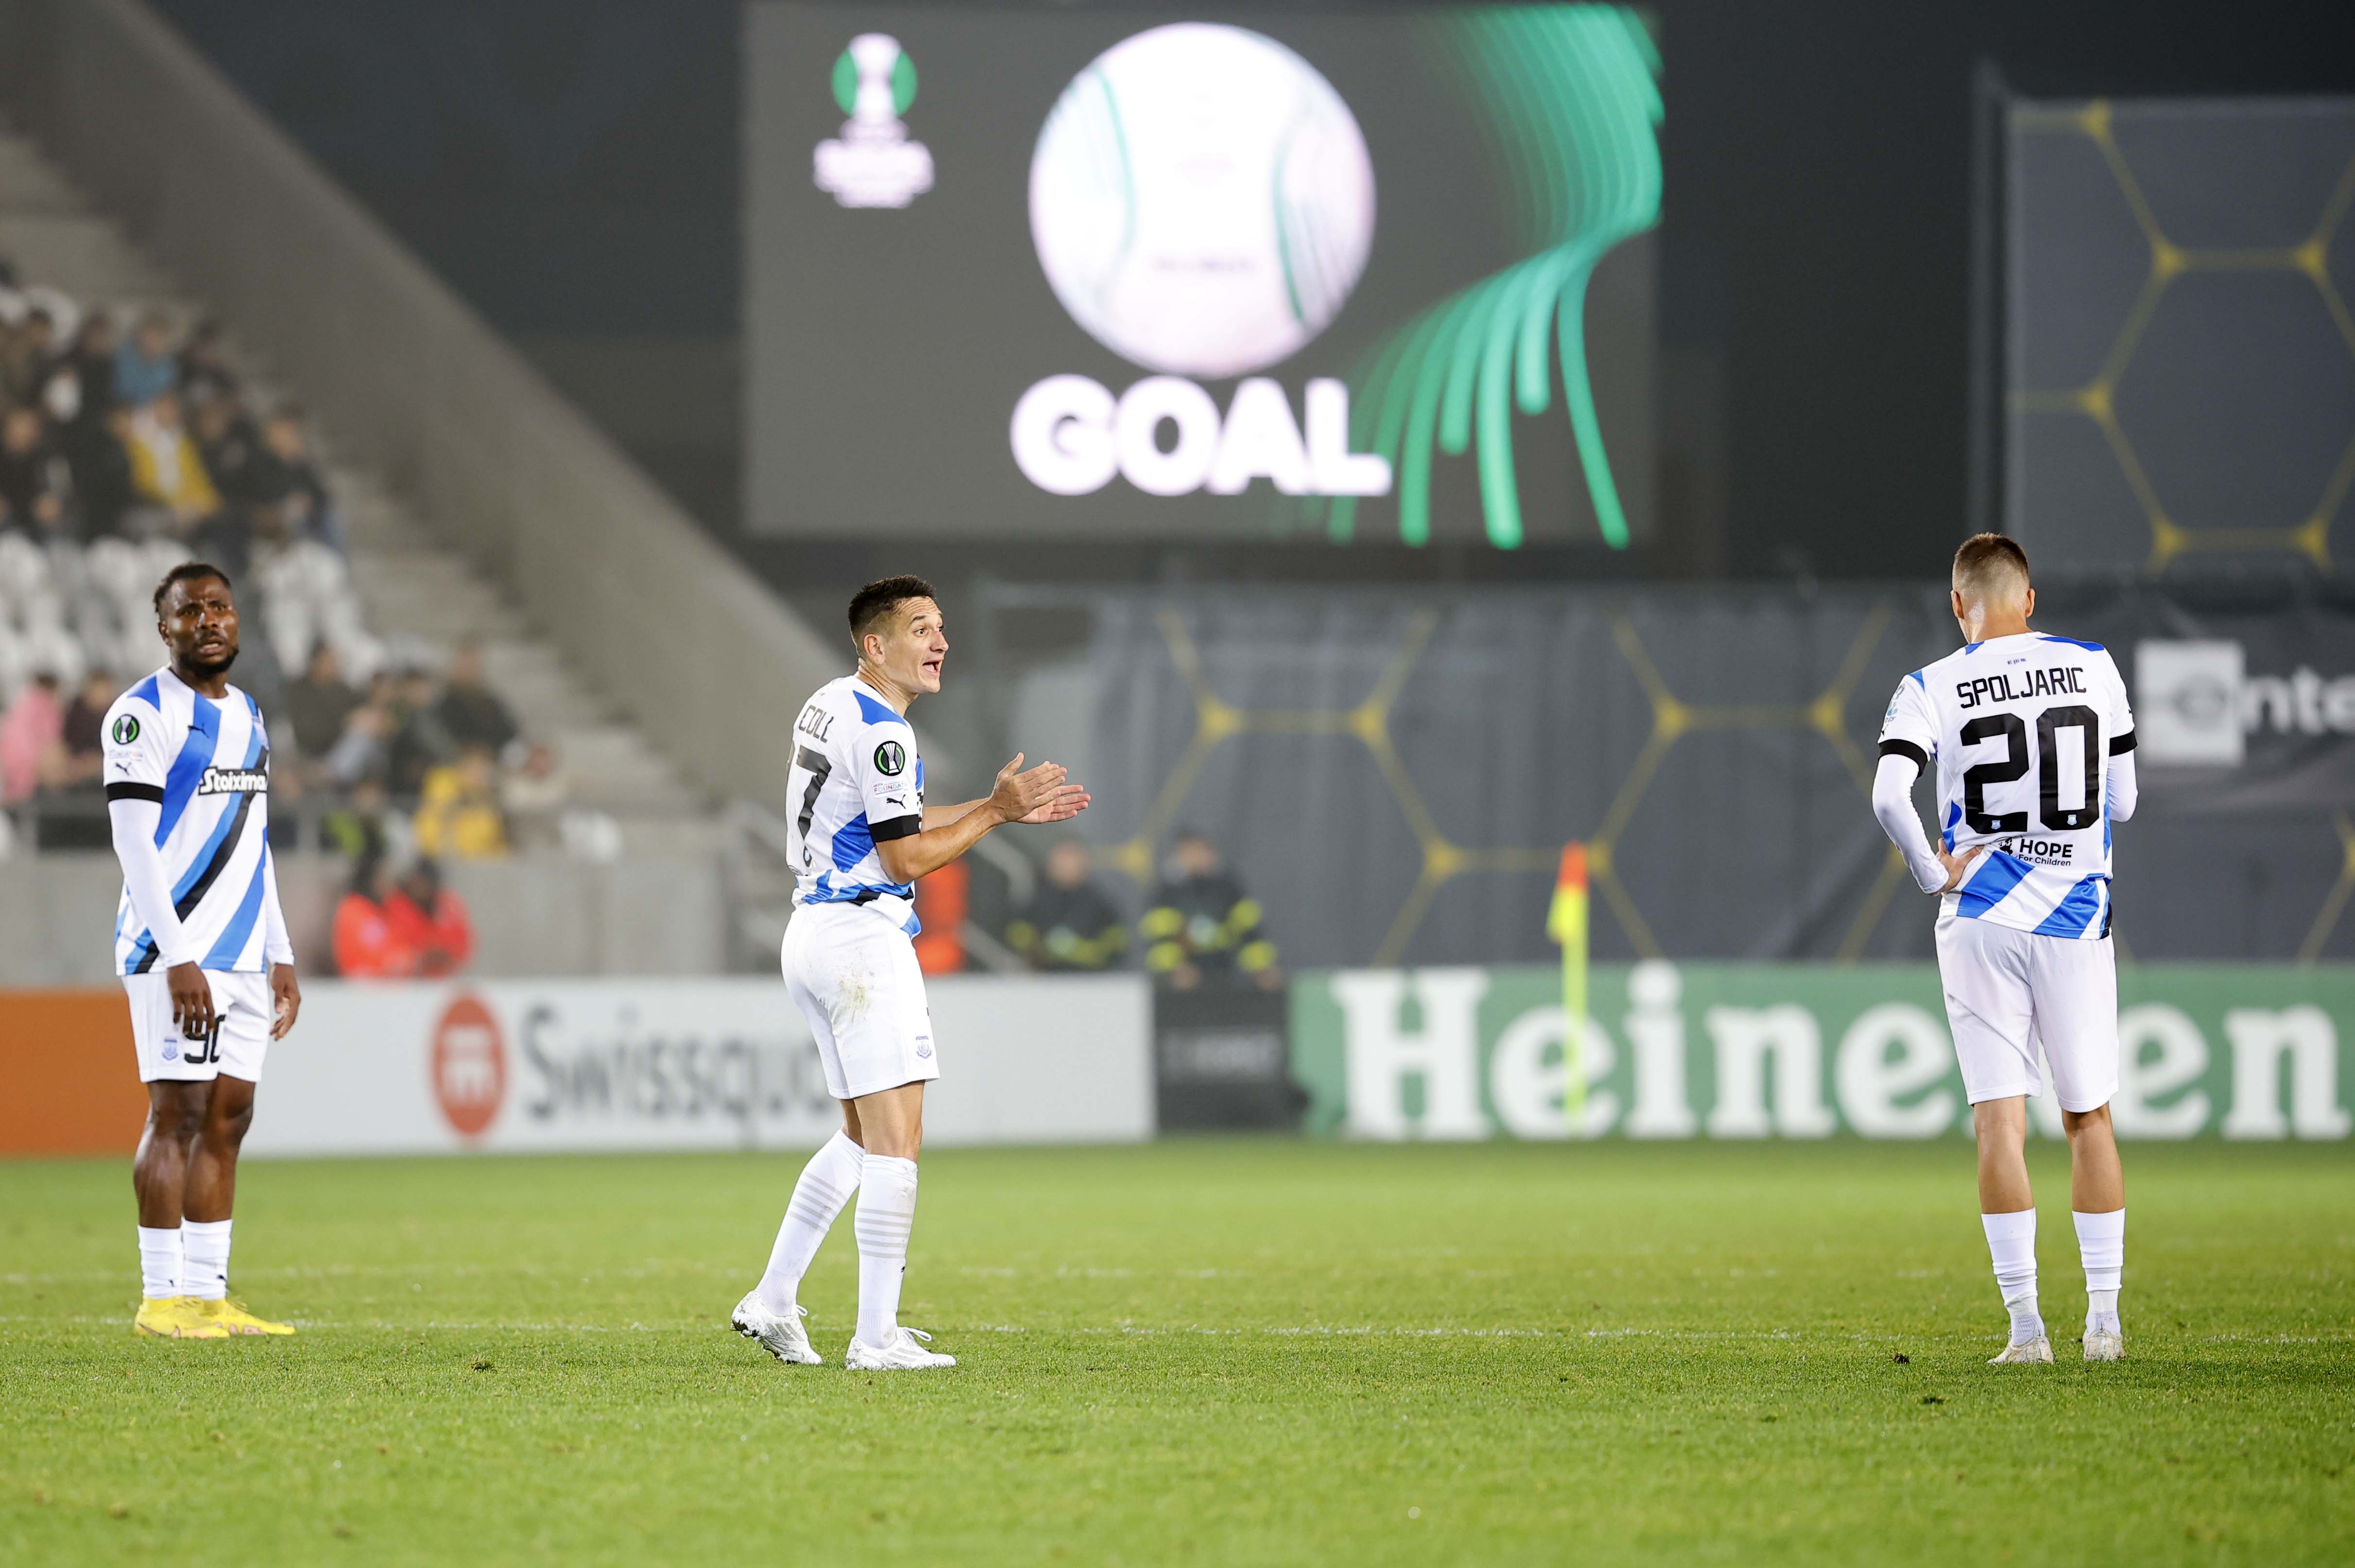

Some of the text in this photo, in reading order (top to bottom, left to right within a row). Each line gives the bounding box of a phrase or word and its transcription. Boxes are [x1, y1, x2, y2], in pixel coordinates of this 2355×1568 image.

[1010, 374, 1393, 496] GOAL
[1957, 667, 2086, 709] SPOLJARIC
[200, 767, 267, 794] Stoixima
[1960, 705, 2099, 835] 20
[2019, 838, 2073, 858] HOPE
[2034, 856, 2071, 866] Children
[1330, 959, 2353, 1139] Heineen
